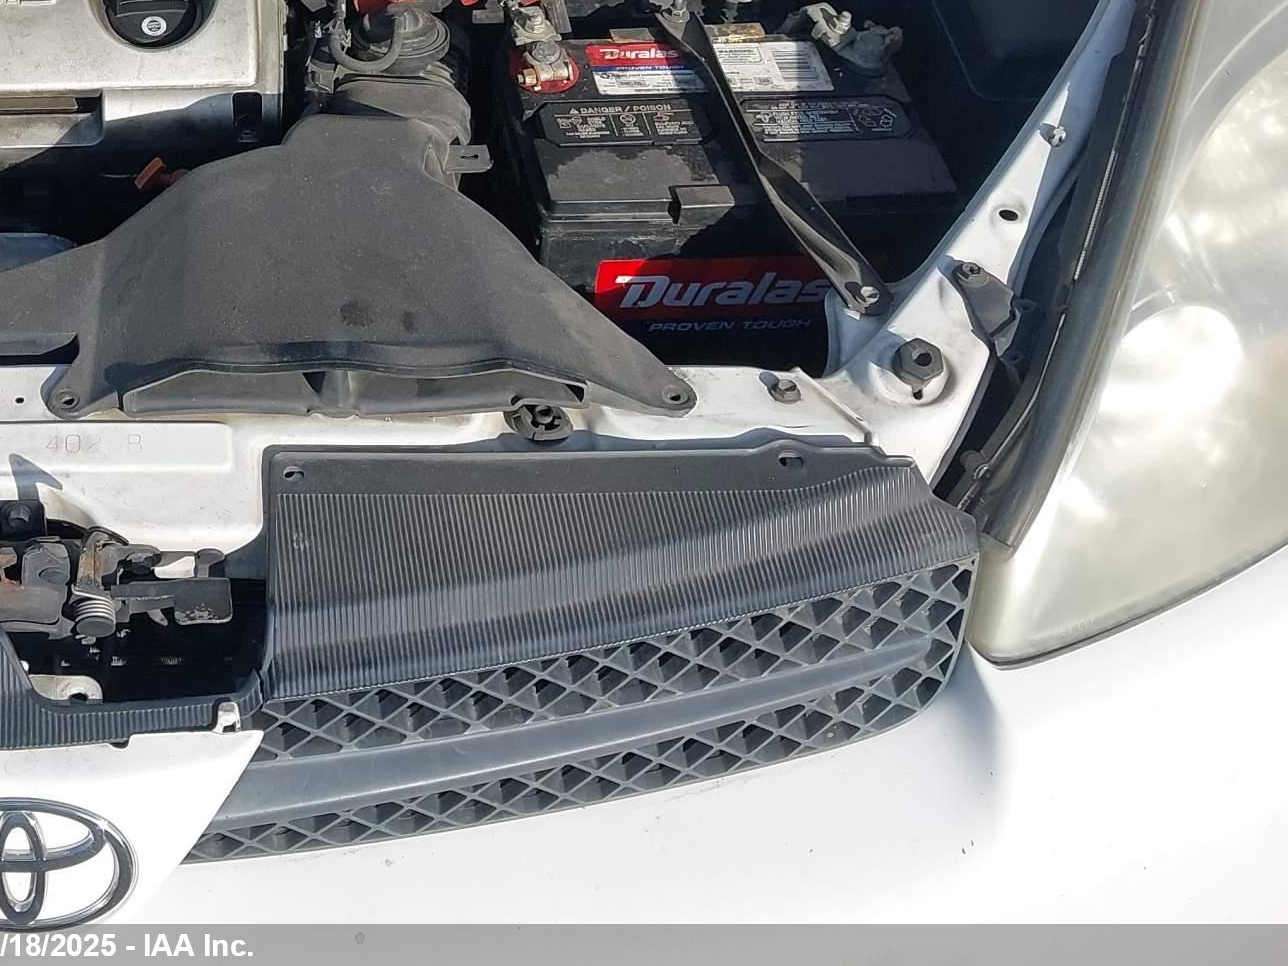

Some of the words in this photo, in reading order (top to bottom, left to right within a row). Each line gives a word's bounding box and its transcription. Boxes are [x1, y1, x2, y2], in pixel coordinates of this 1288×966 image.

[599, 47, 681, 60] Duralas
[580, 106, 623, 114] DANGER
[632, 104, 672, 112] POISON
[615, 272, 834, 308] Duralas
[648, 321, 735, 332] PROVEN
[743, 319, 812, 330] TOUGH
